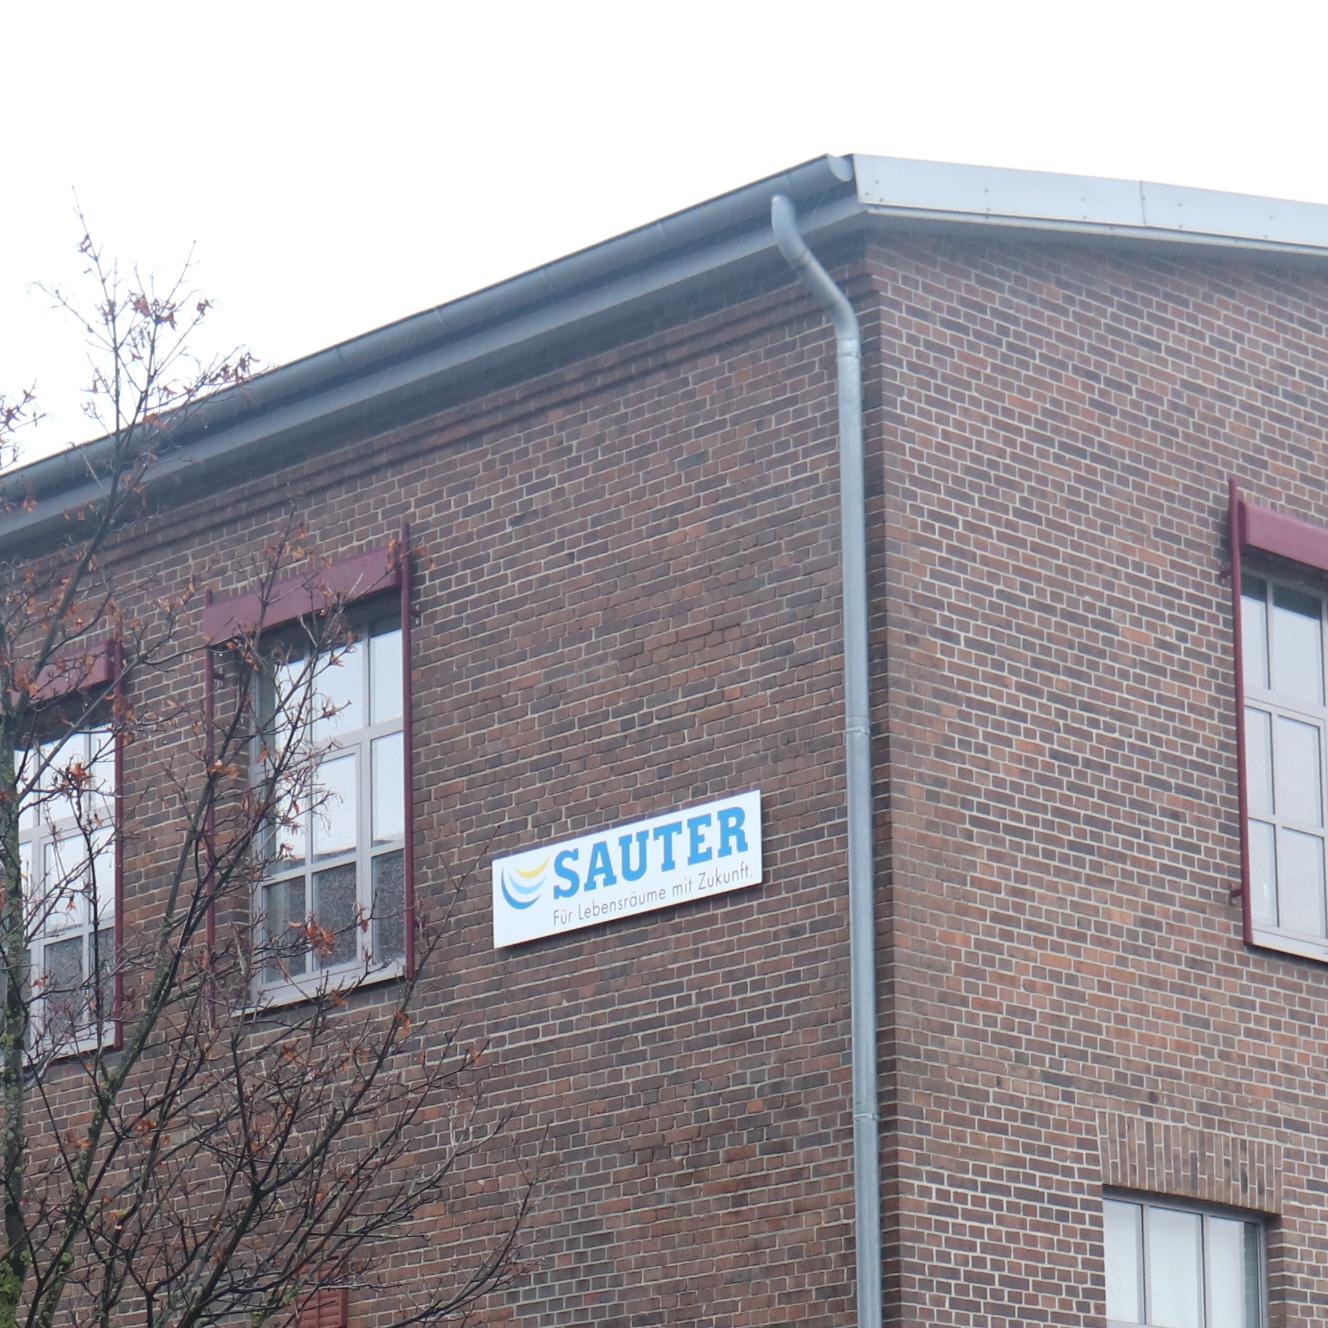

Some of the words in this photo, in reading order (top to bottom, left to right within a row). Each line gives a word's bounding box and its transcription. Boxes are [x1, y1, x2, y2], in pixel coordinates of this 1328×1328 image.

[553, 806, 749, 900] SAUTER
[553, 908, 573, 927] Für
[578, 887, 667, 921] Lebensräume
[672, 878, 693, 897] mit
[697, 860, 753, 890] Zukunft.
